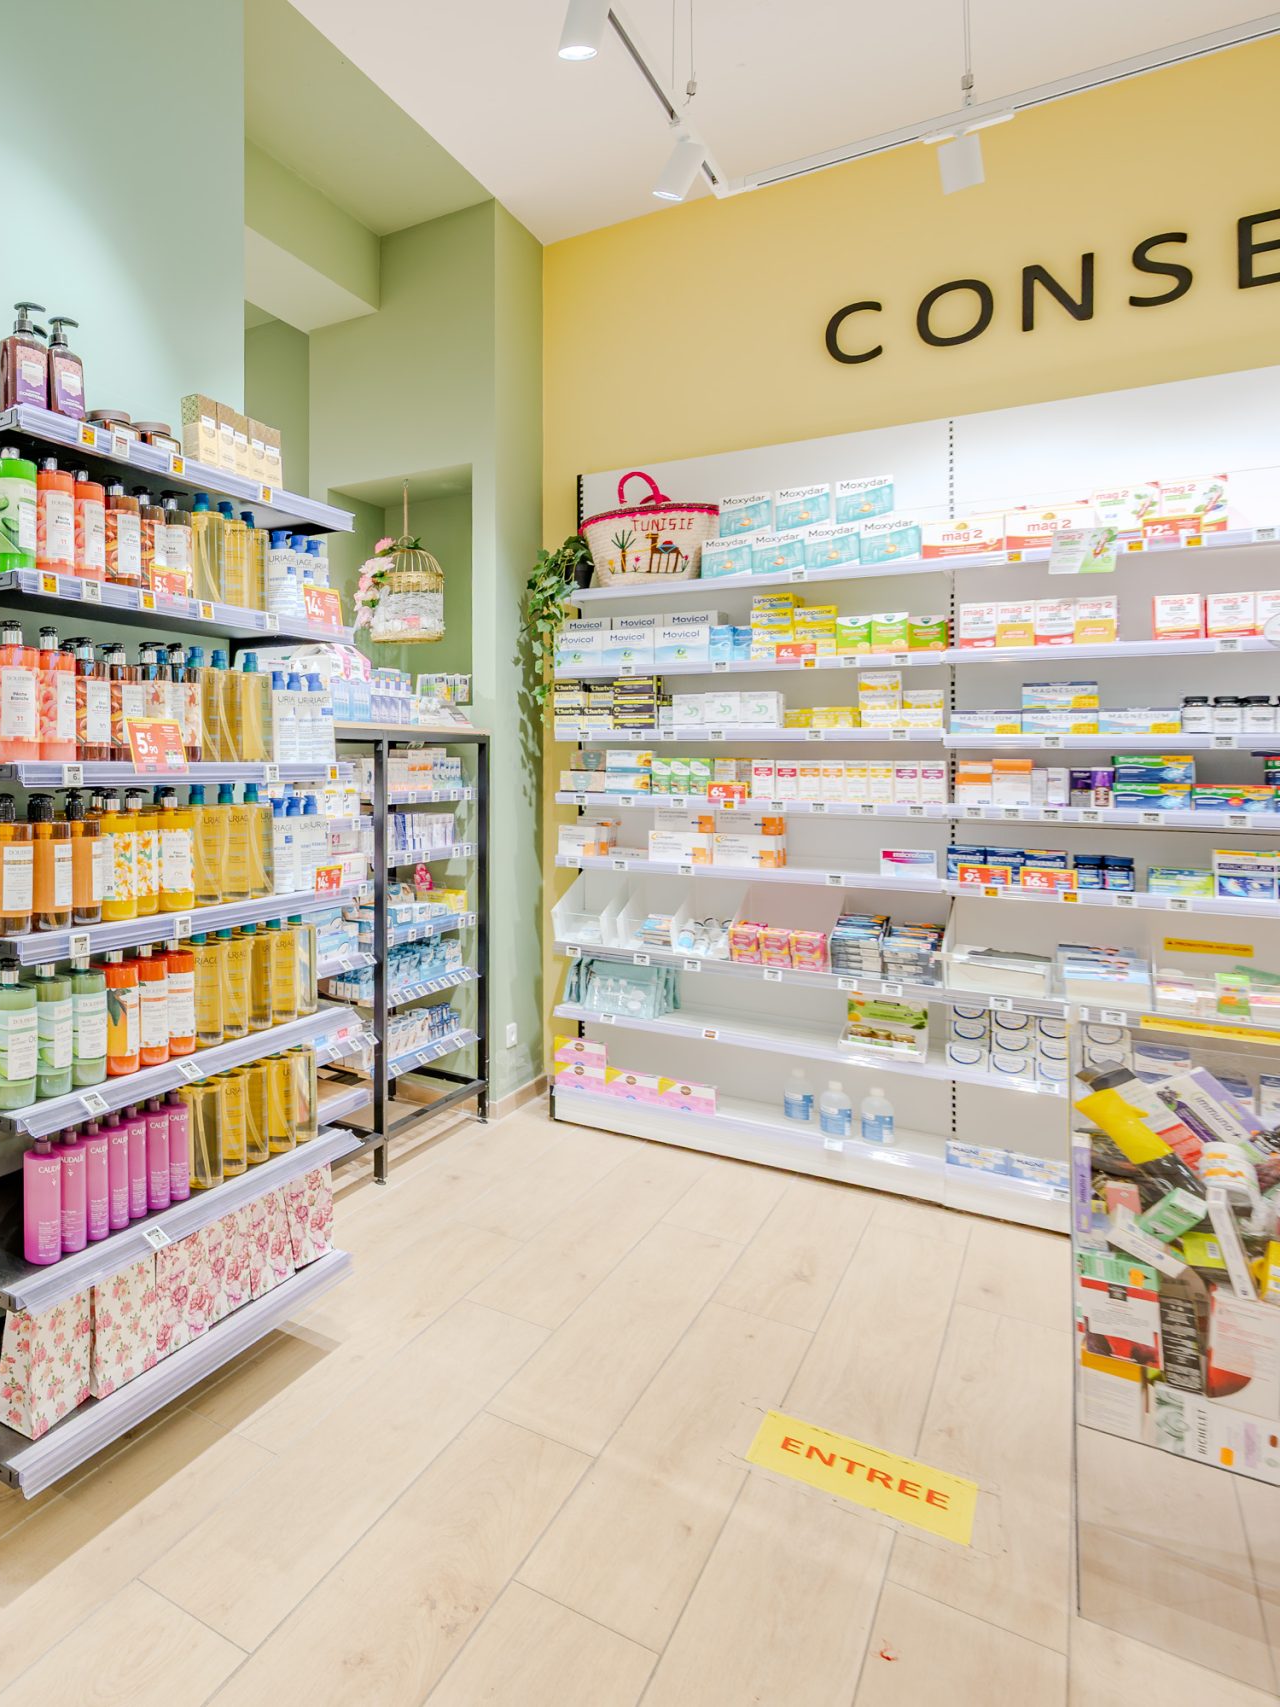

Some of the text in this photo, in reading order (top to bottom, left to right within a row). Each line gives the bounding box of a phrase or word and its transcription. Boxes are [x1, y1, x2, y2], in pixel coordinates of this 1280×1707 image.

[825, 208, 1280, 365] CONSE
[840, 478, 888, 490] Moxydar
[1160, 485, 1185, 494] mag
[780, 486, 825, 499] Moxydar
[1096, 492, 1120, 500] mag
[723, 494, 767, 507] Moxydar
[631, 518, 694, 532] TUNISIE
[864, 519, 913, 532] Moxydar
[1027, 520, 1071, 532] mag 2
[808, 526, 855, 539] Moxydar
[942, 530, 983, 542] mag 2
[706, 537, 748, 549] Moxydar
[756, 532, 799, 546] Moxydar
[1039, 605, 1062, 613] mag
[1079, 602, 1102, 610] mag
[672, 615, 708, 623] Movicol
[561, 636, 594, 644] Movicol
[781, 1436, 950, 1510] ENTREE
